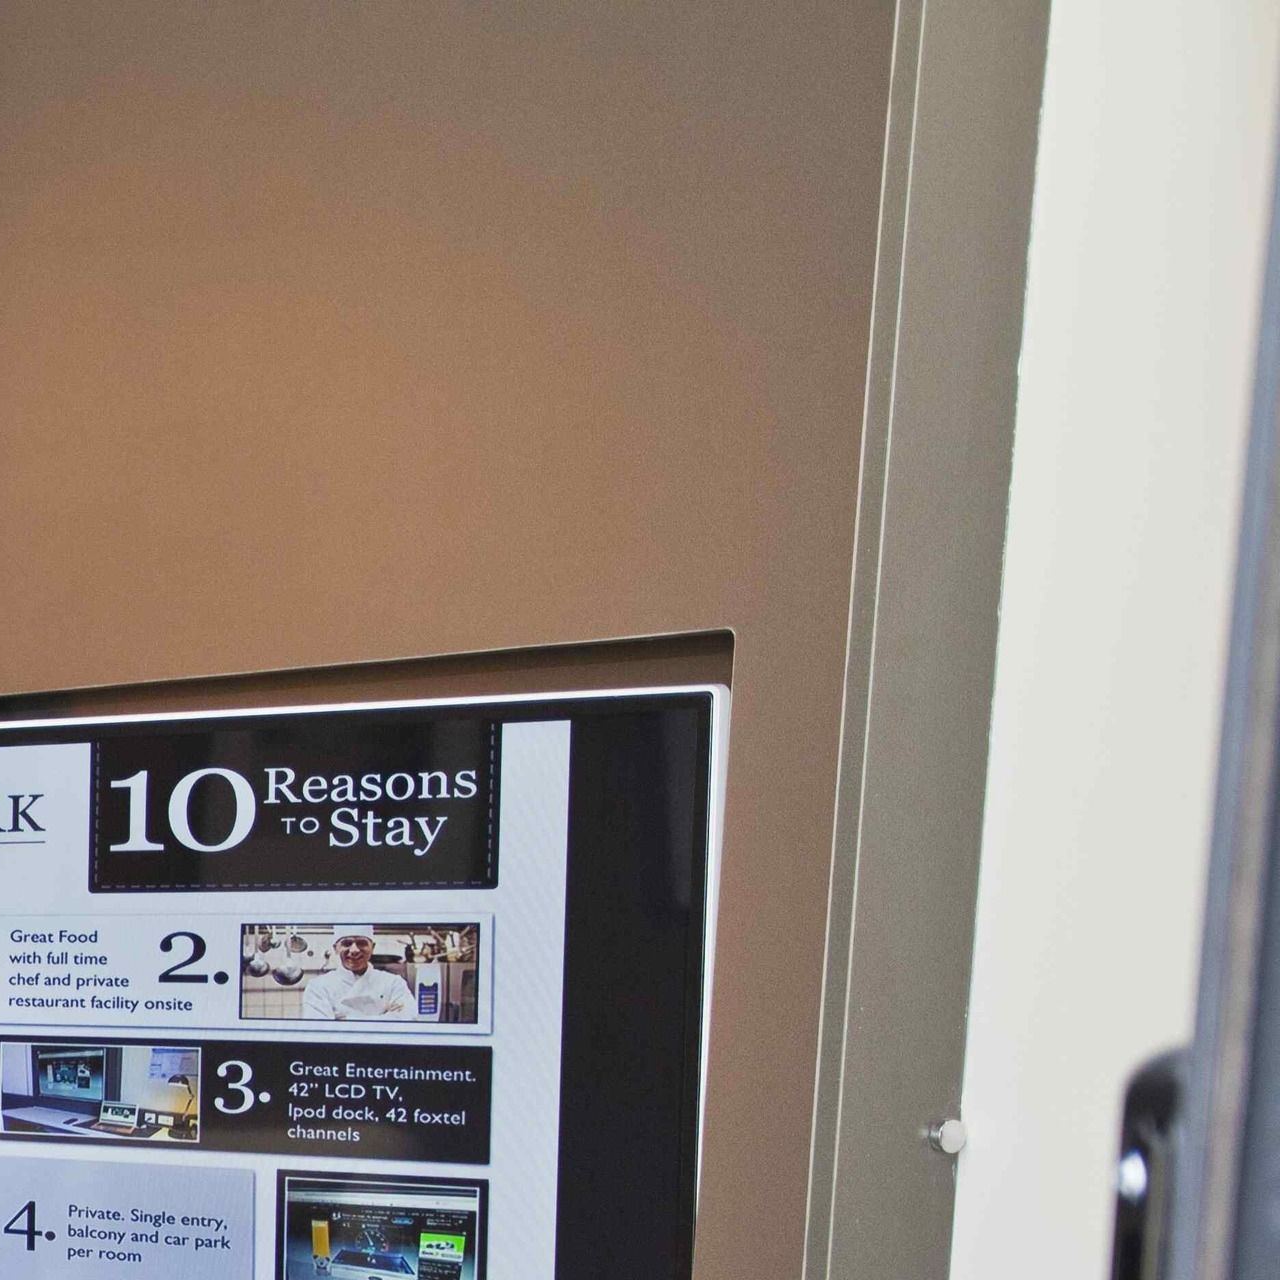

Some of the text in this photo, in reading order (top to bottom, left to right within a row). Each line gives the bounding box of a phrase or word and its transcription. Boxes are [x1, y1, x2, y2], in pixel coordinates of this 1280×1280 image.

[109, 766, 479, 853] 10 Reasons
[281, 807, 448, 857] TO Stay
[9, 928, 98, 944] Great Food
[8, 950, 108, 966] with full time
[157, 930, 229, 985] 2.
[8, 972, 130, 992] chef and private
[8, 995, 193, 1014] restaurant facility onsite
[289, 1061, 477, 1082] Great Entertainment.
[214, 1060, 272, 1114] 3.
[325, 1083, 367, 1100] LCD
[288, 1104, 466, 1127] Ipod dock, 42 foxtel
[287, 1124, 361, 1142] channels
[3, 1200, 56, 1251] 4.
[68, 1204, 228, 1231] Private. Single entry,
[67, 1225, 231, 1254] balcony and car park
[67, 1248, 142, 1264] per room
